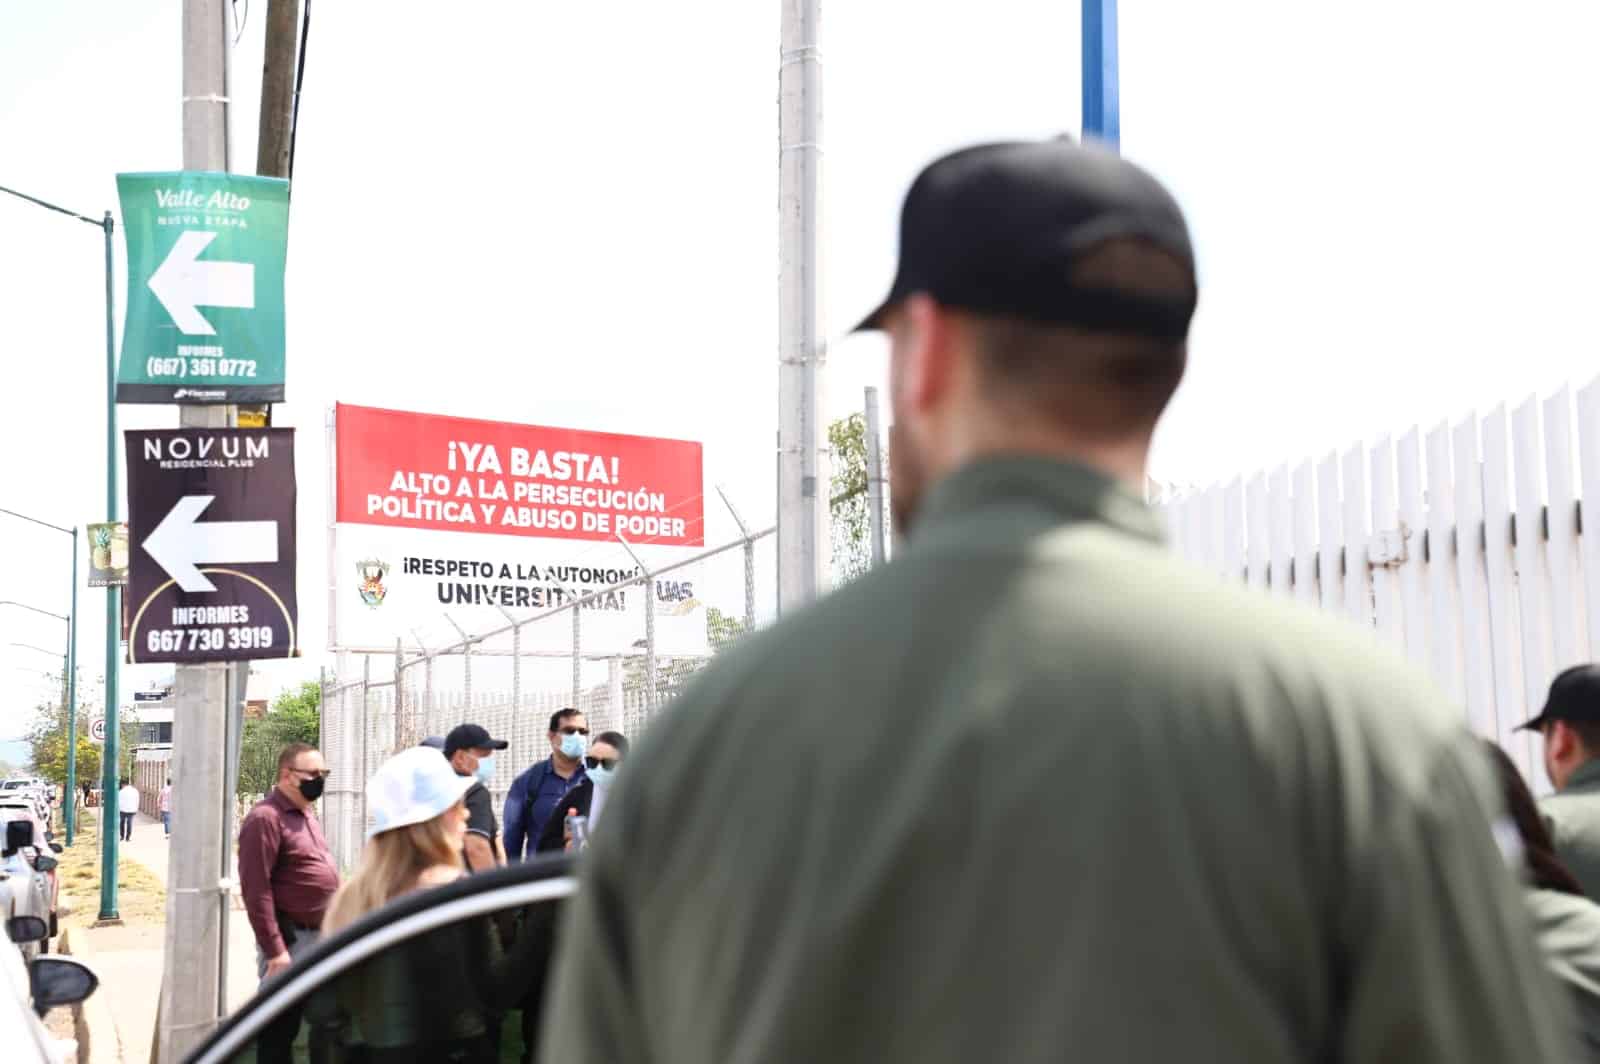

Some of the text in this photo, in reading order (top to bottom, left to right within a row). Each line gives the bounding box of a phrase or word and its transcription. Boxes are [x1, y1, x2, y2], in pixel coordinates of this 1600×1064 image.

[155, 189, 250, 210] Valle Alto
[147, 356, 187, 378] (667)
[144, 436, 269, 460] NOVUM
[160, 459, 254, 469] RESIDENCIAL PLUS
[511, 447, 619, 484] BASTA!
[390, 470, 665, 513] ALTO A LA PERSECUCIÓN
[367, 493, 685, 537] POLÍTICA Y ABUSO DE PODER
[499, 563, 512, 580] A
[517, 564, 541, 581] LA
[172, 605, 249, 626] INFORMES
[147, 626, 273, 652] 667 730 3919
